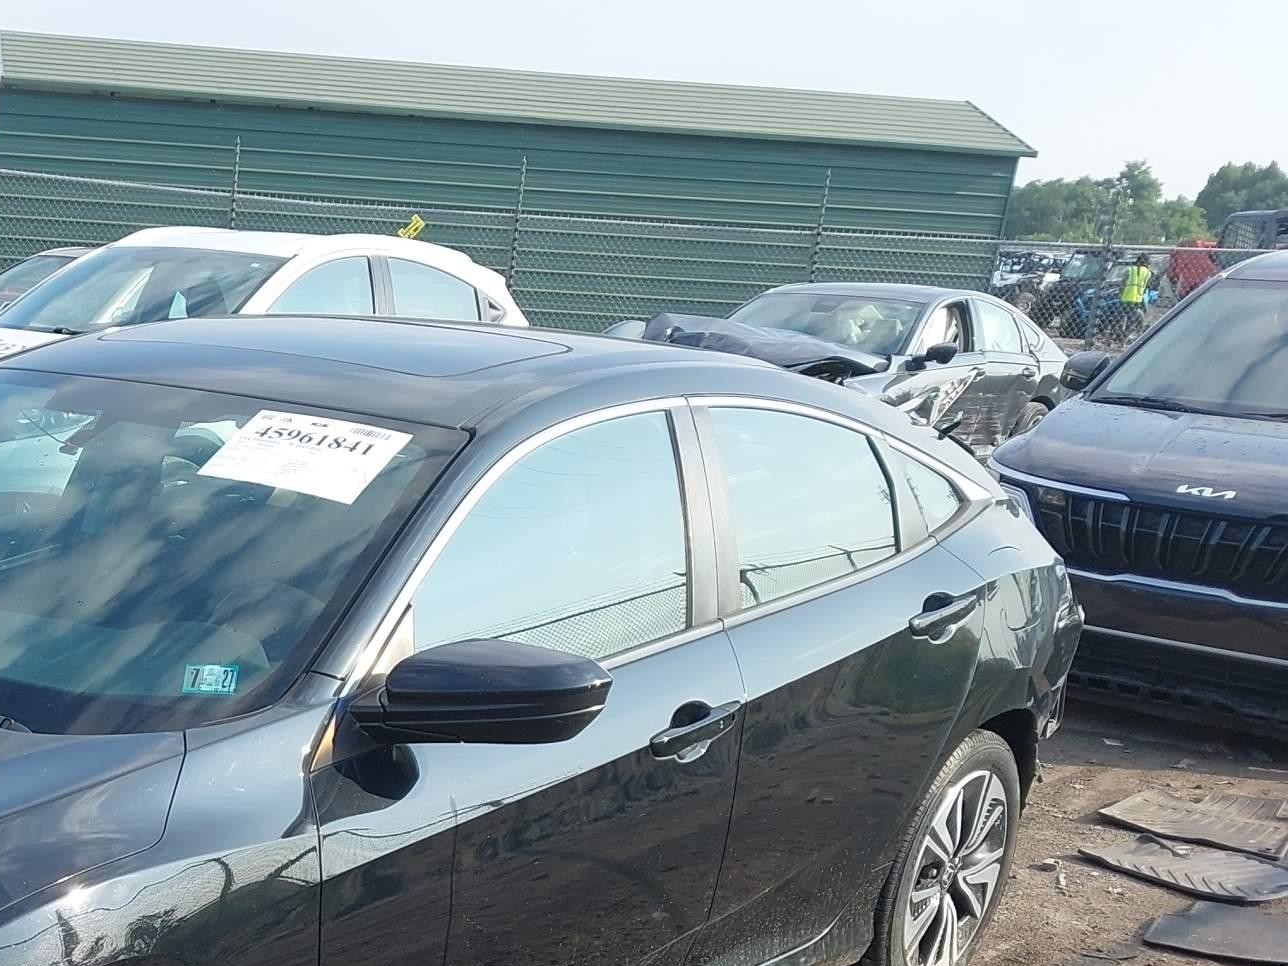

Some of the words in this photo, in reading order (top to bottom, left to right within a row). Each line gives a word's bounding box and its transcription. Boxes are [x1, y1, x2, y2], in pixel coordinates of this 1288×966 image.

[255, 425, 376, 456] 45961841
[190, 668, 201, 689] 7
[221, 668, 235, 693] 27
